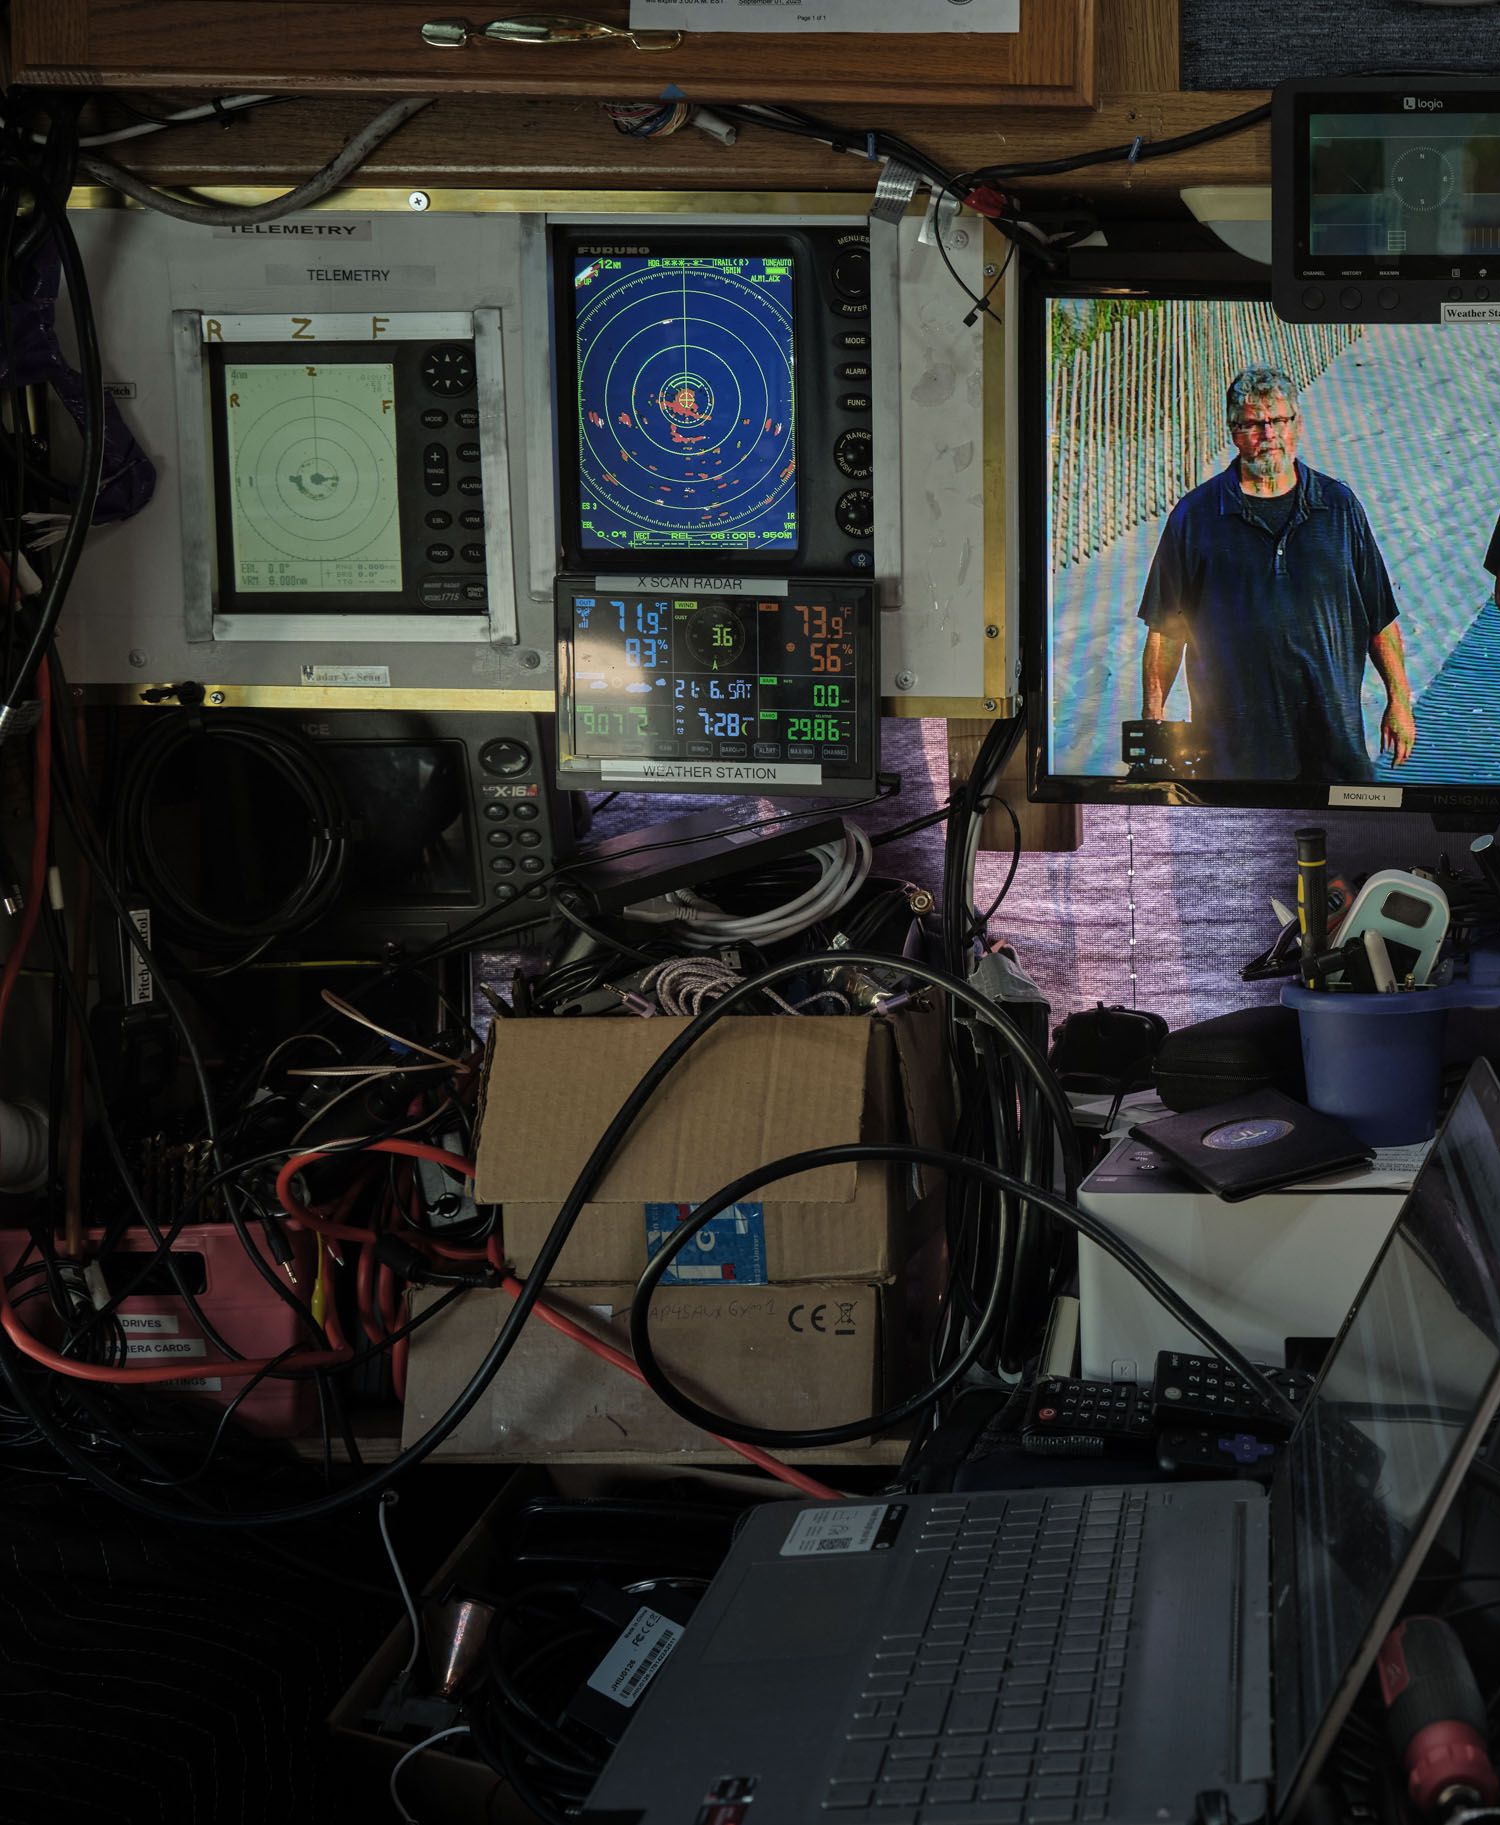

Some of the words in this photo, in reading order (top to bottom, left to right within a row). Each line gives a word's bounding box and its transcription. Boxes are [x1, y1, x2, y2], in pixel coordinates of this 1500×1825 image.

[1417, 98, 1443, 111] logia
[307, 269, 391, 282] TELEMETRY
[842, 305, 868, 313] ENTER
[1447, 308, 1486, 318] Weather
[206, 318, 224, 342] R
[291, 317, 315, 340] Z
[372, 316, 390, 339] F
[382, 400, 392, 414] F
[846, 432, 872, 441] RANGE
[845, 524, 863, 537] DATA
[637, 577, 647, 588] X
[650, 577, 689, 589] SCAN
[693, 578, 742, 590] RADAR
[794, 605, 843, 639] 73.9
[712, 627, 732, 646] 3.6
[625, 638, 657, 667] 83
[810, 643, 842, 672] 56
[729, 684, 752, 699] SAT
[814, 685, 839, 707] 0.0
[698, 712, 740, 737] 7:28
[788, 718, 839, 741] 29.86
[643, 766, 713, 778] WEATHER
[716, 766, 777, 780] STATION
[1434, 795, 1500, 806] INSIGNIA
[138, 968, 149, 999] Pitch
[121, 1319, 162, 1328] DRIVES
[154, 1344, 191, 1352] CARDS
